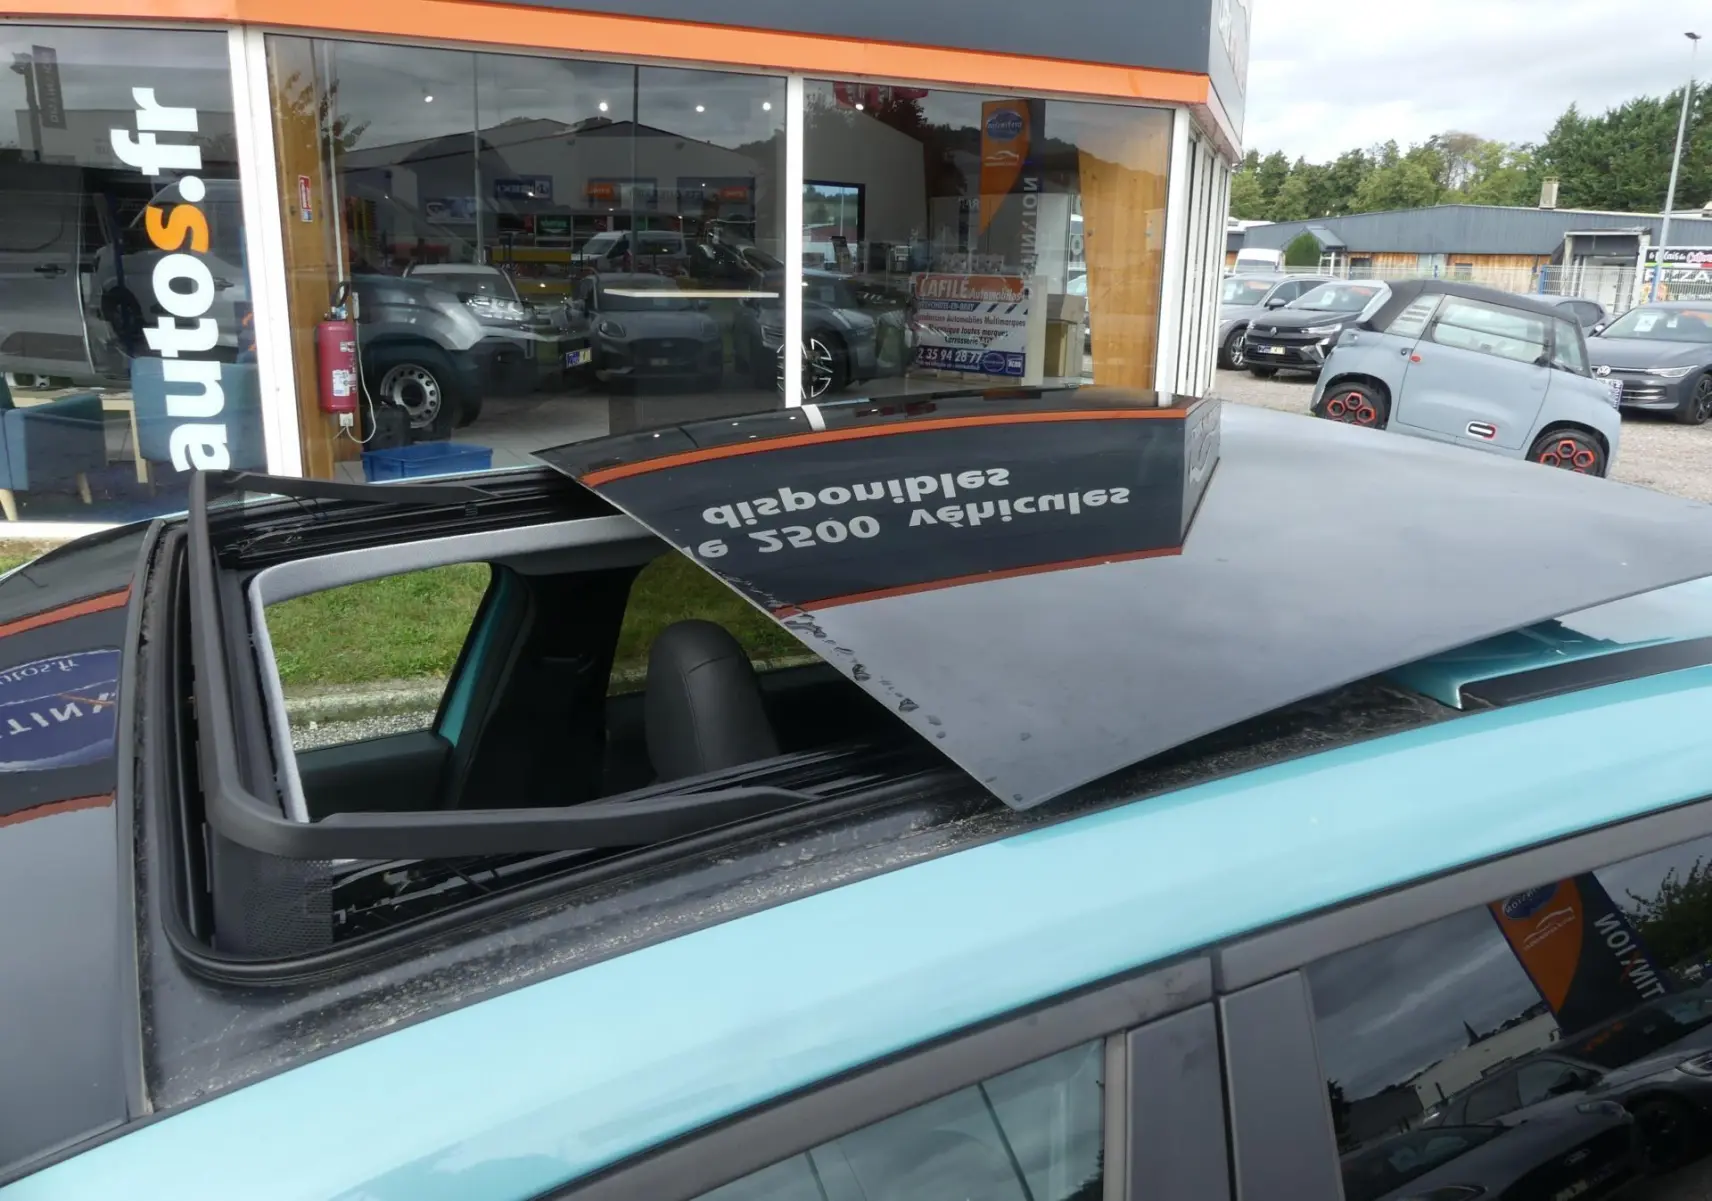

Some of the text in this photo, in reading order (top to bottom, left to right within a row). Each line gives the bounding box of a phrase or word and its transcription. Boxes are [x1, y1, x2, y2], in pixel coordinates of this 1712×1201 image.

[110, 87, 231, 472] autos.fr
[984, 315, 1026, 328] Multimarques
[926, 348, 938, 360] 35
[939, 349, 952, 361] 94
[954, 350, 967, 363] 28
